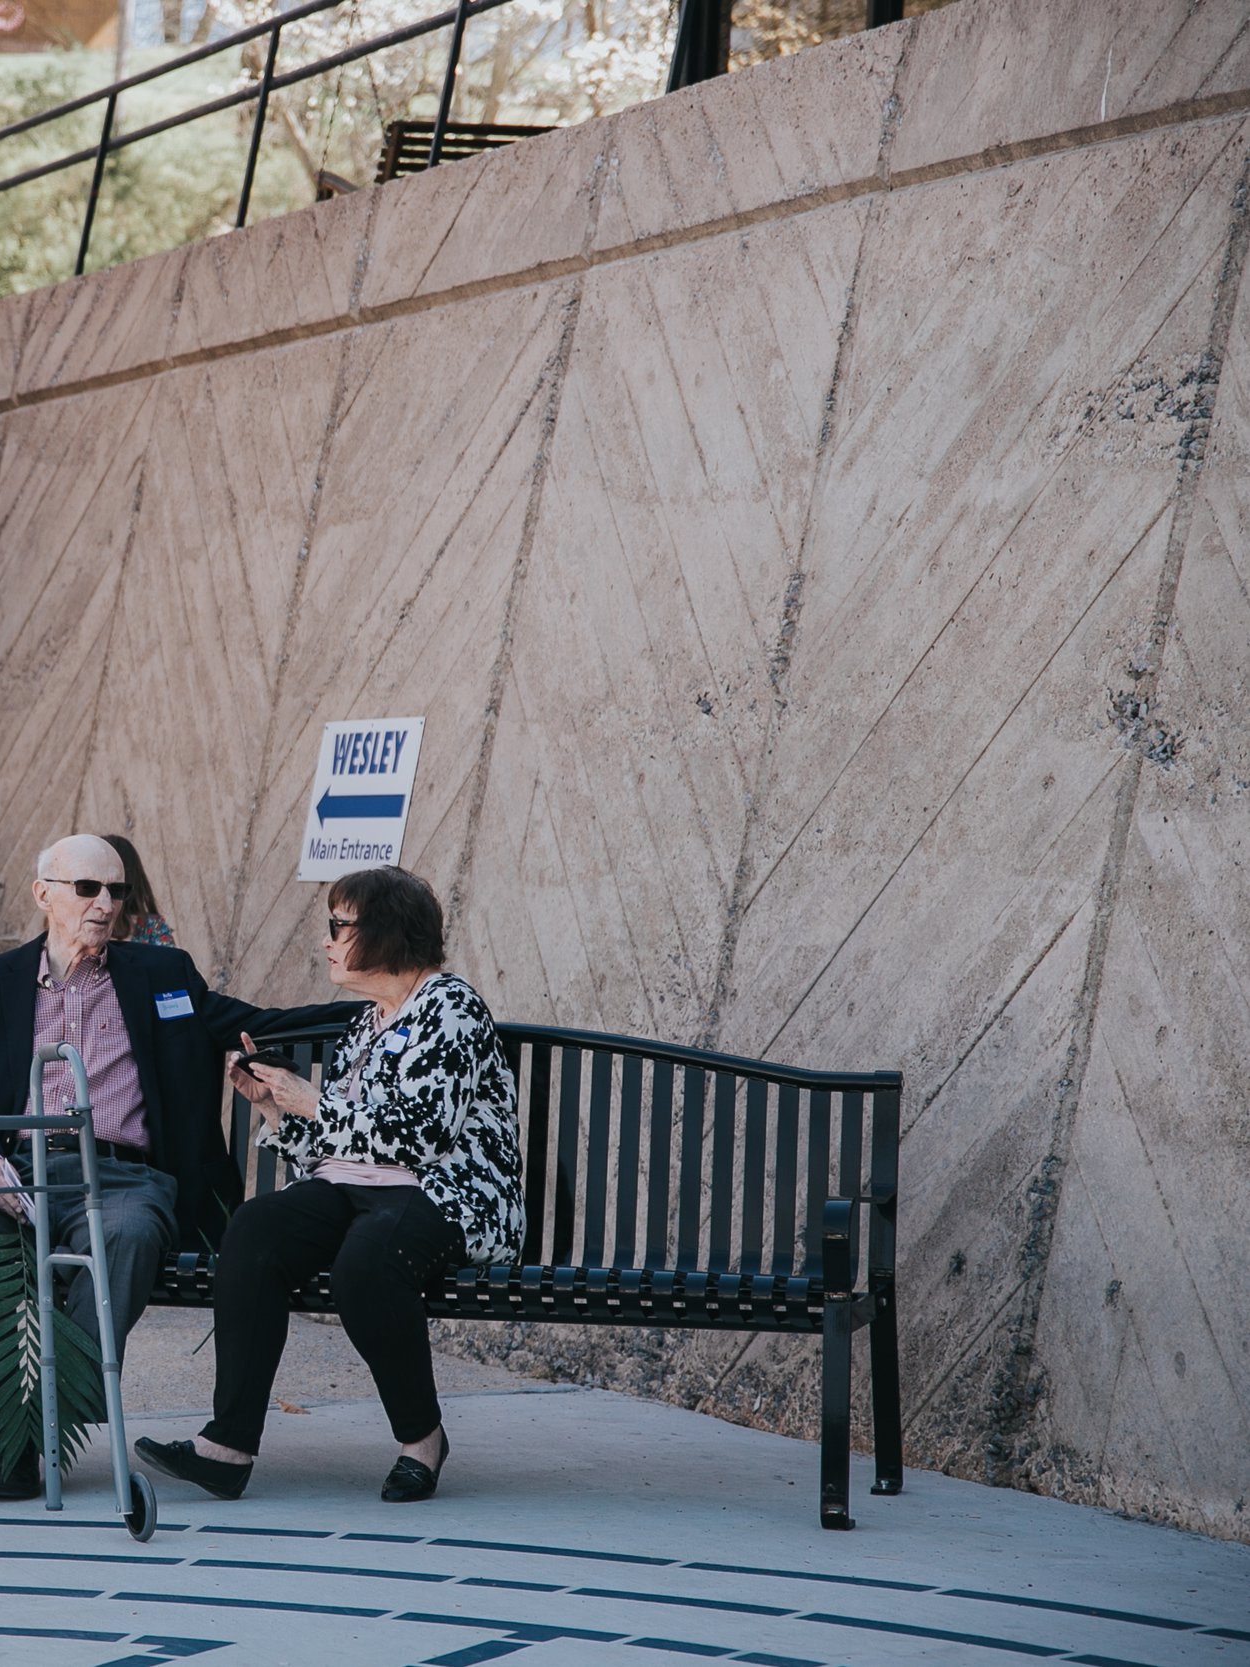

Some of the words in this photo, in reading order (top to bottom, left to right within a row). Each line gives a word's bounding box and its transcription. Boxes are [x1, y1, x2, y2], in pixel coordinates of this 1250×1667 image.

[333, 730, 408, 775] WESLEY
[309, 839, 337, 860] Main
[339, 838, 393, 860] Entrance
